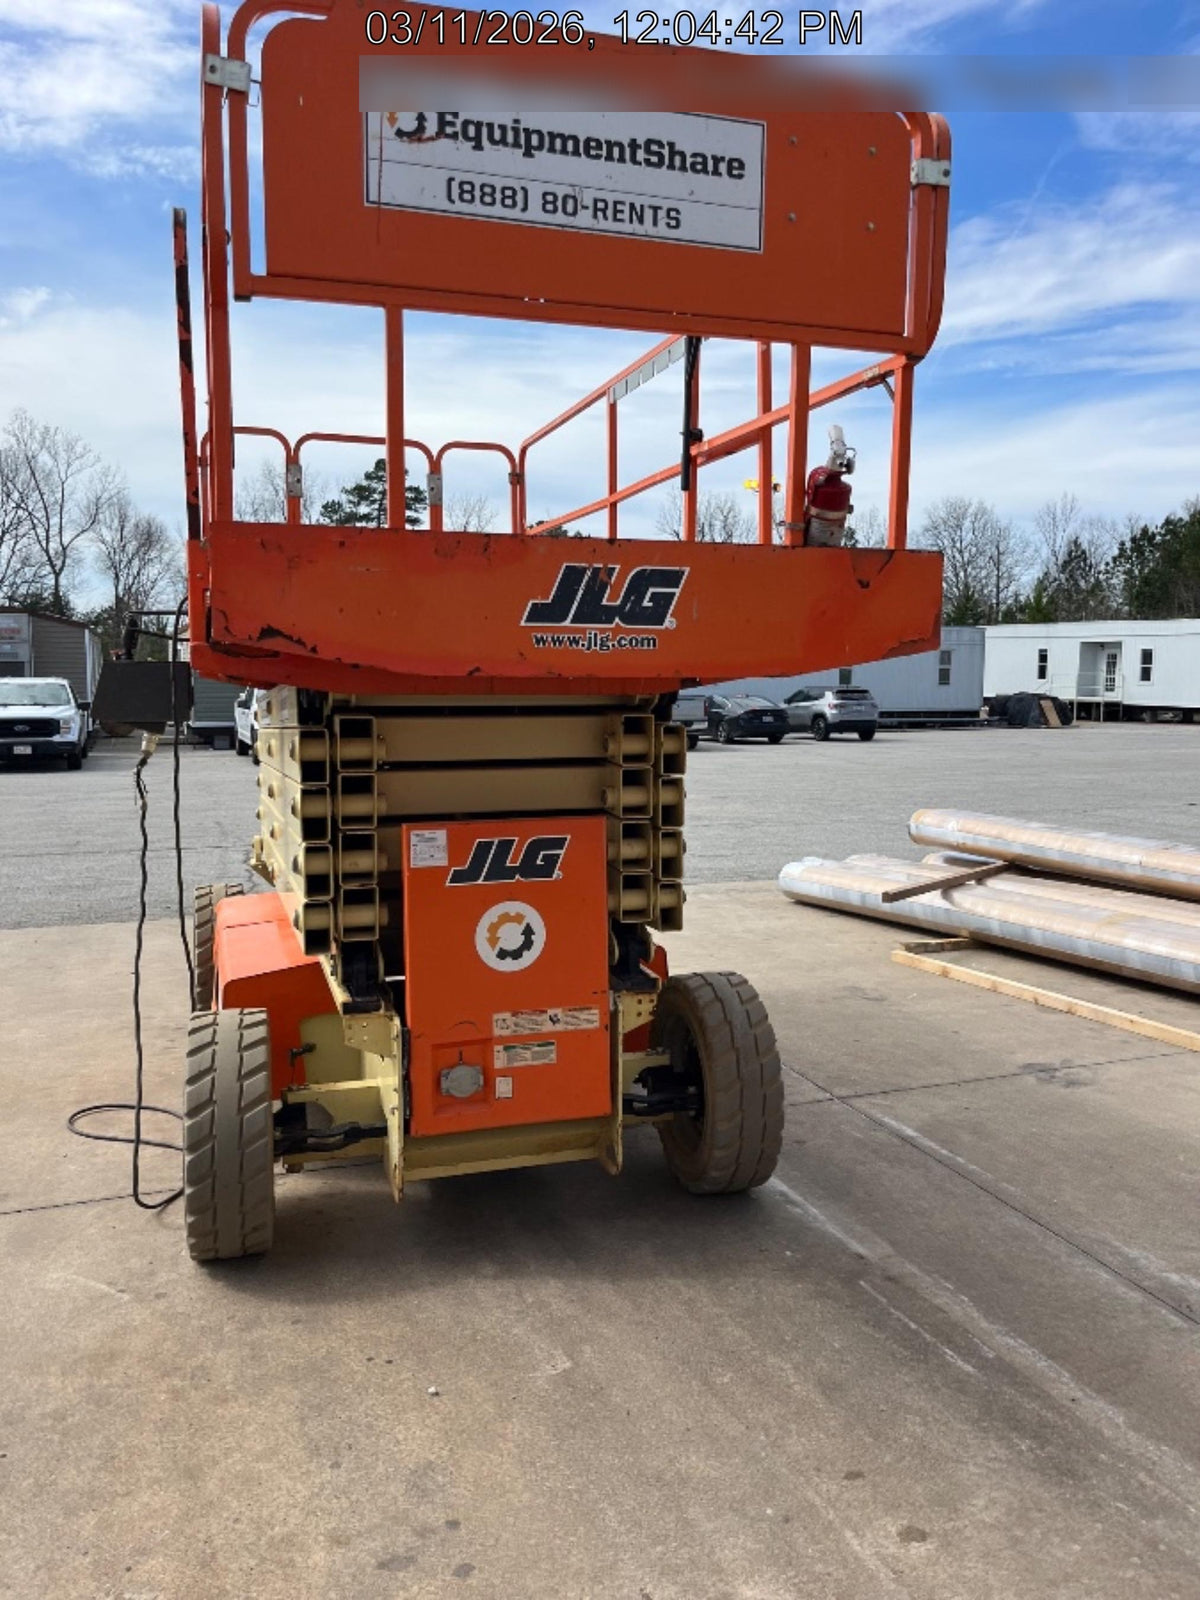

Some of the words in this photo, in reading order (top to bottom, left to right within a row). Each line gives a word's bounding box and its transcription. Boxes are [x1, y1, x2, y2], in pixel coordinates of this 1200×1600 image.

[435, 111, 746, 180] EquipmentShare
[446, 177, 529, 213] (888)
[541, 191, 682, 230] 80-RENTS
[520, 563, 690, 629] JLG
[532, 631, 657, 652] www.jlg.com
[446, 835, 571, 886] JLG
